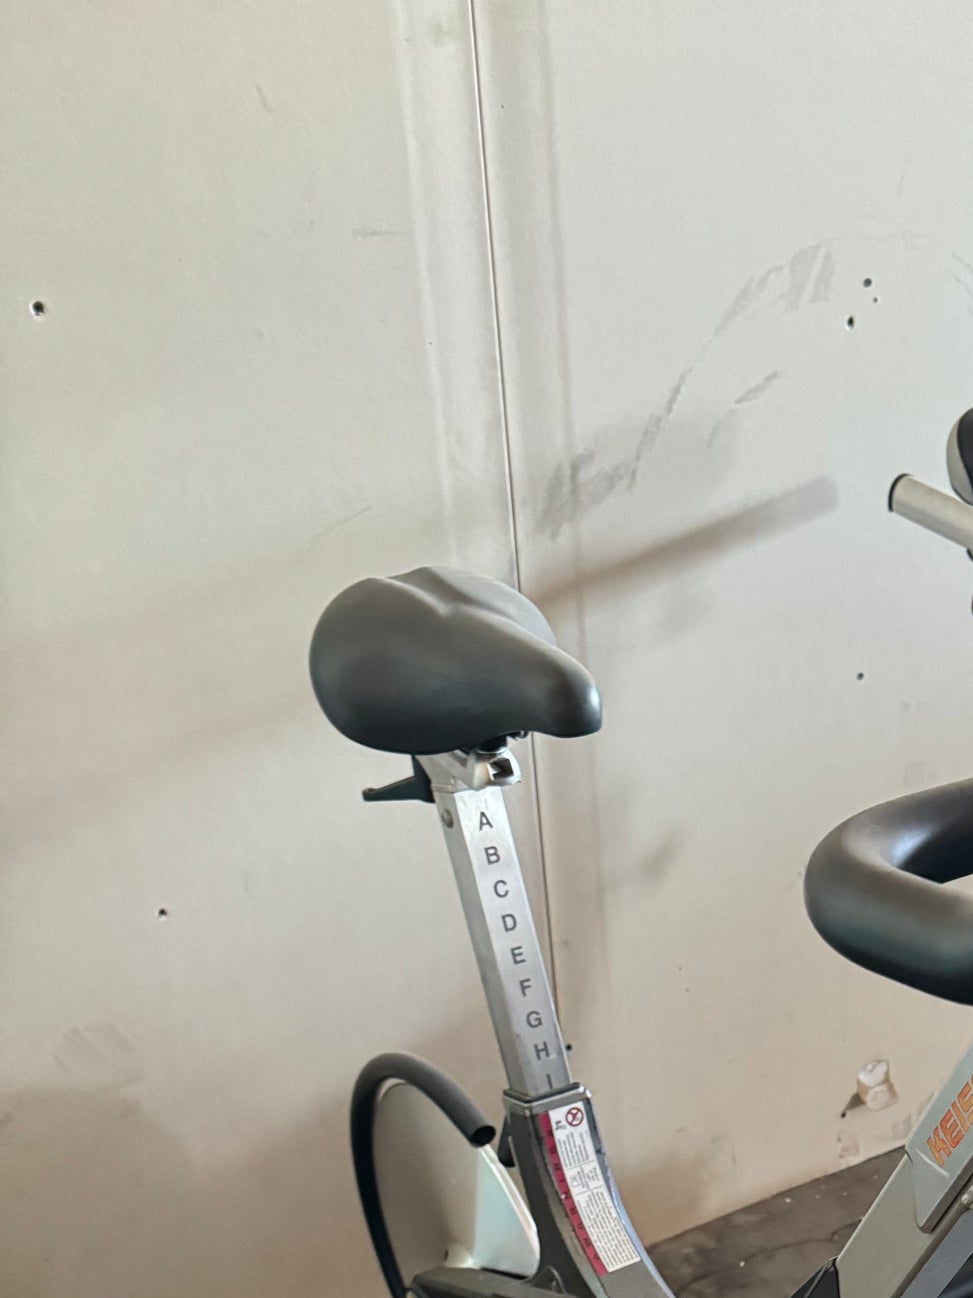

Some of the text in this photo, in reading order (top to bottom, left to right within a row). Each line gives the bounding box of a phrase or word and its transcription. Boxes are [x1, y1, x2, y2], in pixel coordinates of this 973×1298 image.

[478, 811, 494, 831] A
[484, 845, 501, 865] B
[493, 879, 509, 898] C
[501, 913, 517, 932] D
[510, 946, 526, 965] E
[519, 978, 532, 997] F
[526, 1010, 542, 1029] G
[534, 1041, 550, 1060] H
